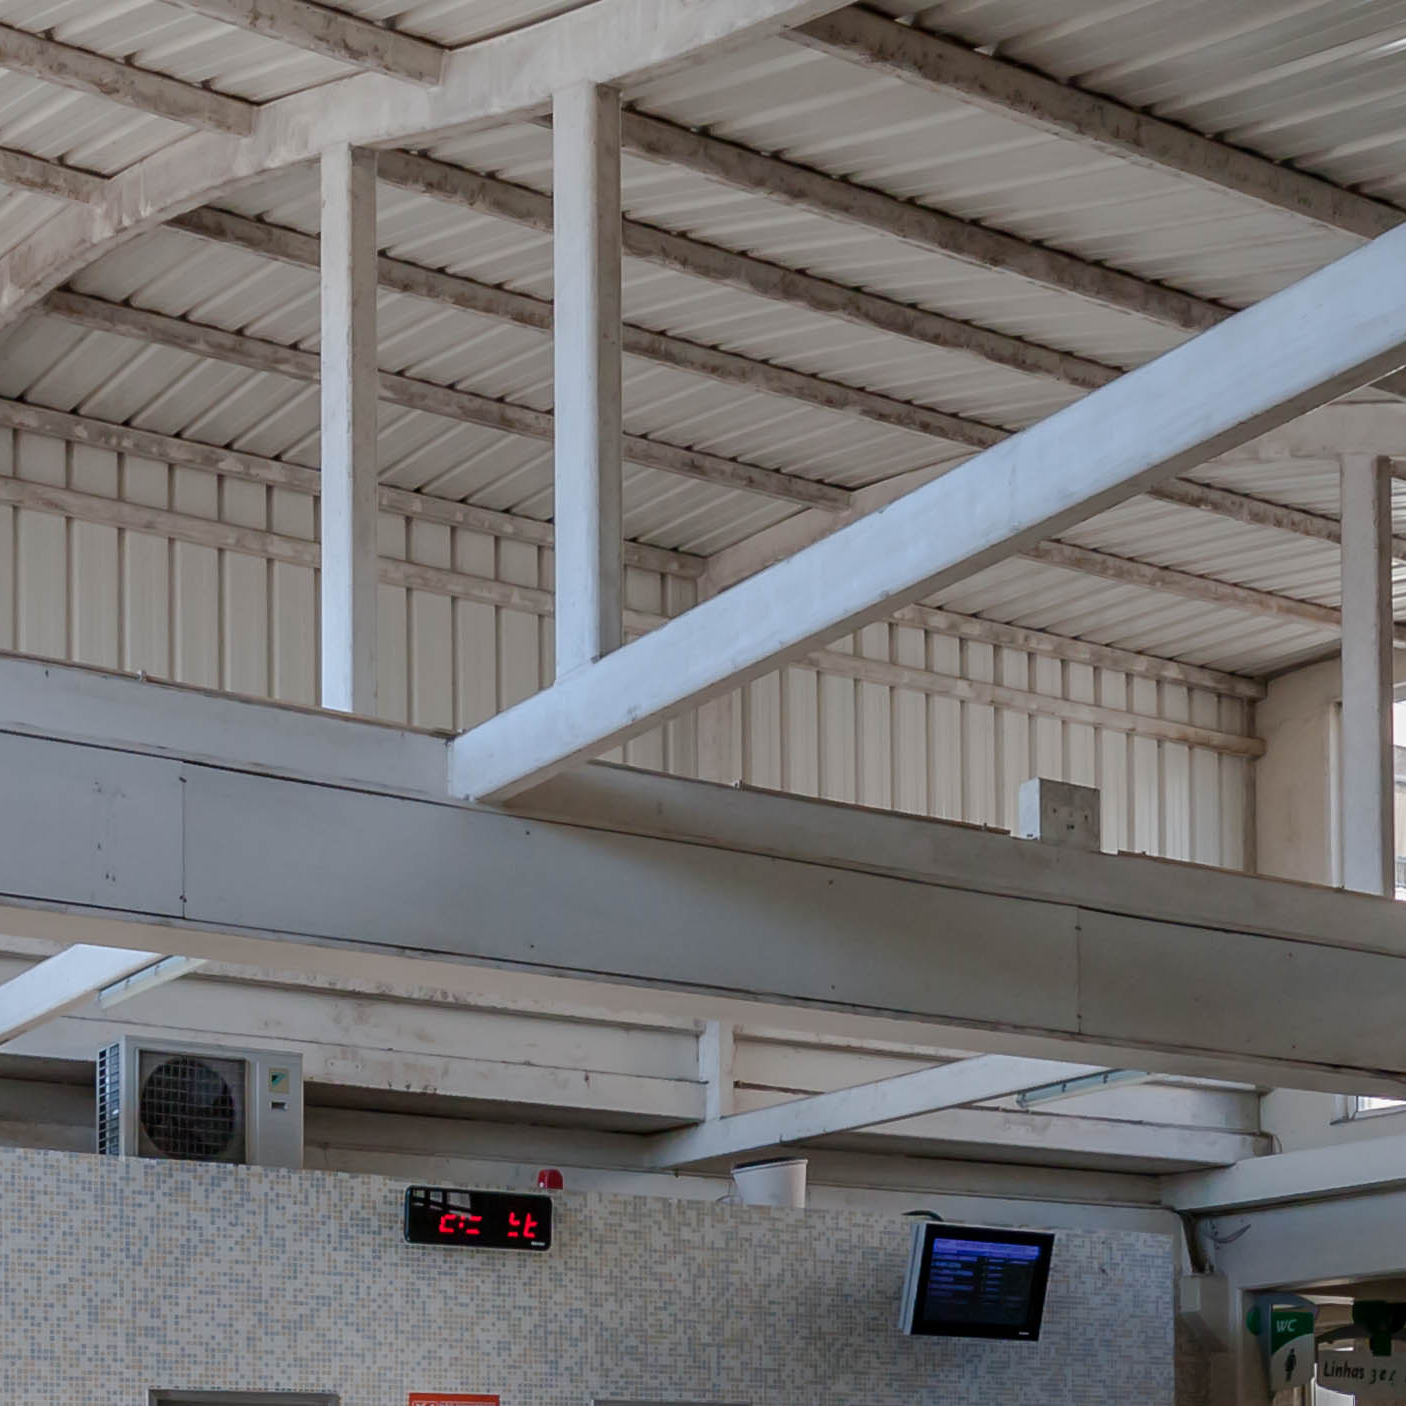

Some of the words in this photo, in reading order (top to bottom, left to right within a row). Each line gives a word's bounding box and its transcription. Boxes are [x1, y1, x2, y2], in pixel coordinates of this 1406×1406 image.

[1276, 1318, 1297, 1332] WC
[1323, 1360, 1364, 1379] Linhas
[1369, 1369, 1377, 1384] 3
[1380, 1369, 1387, 1378] e
